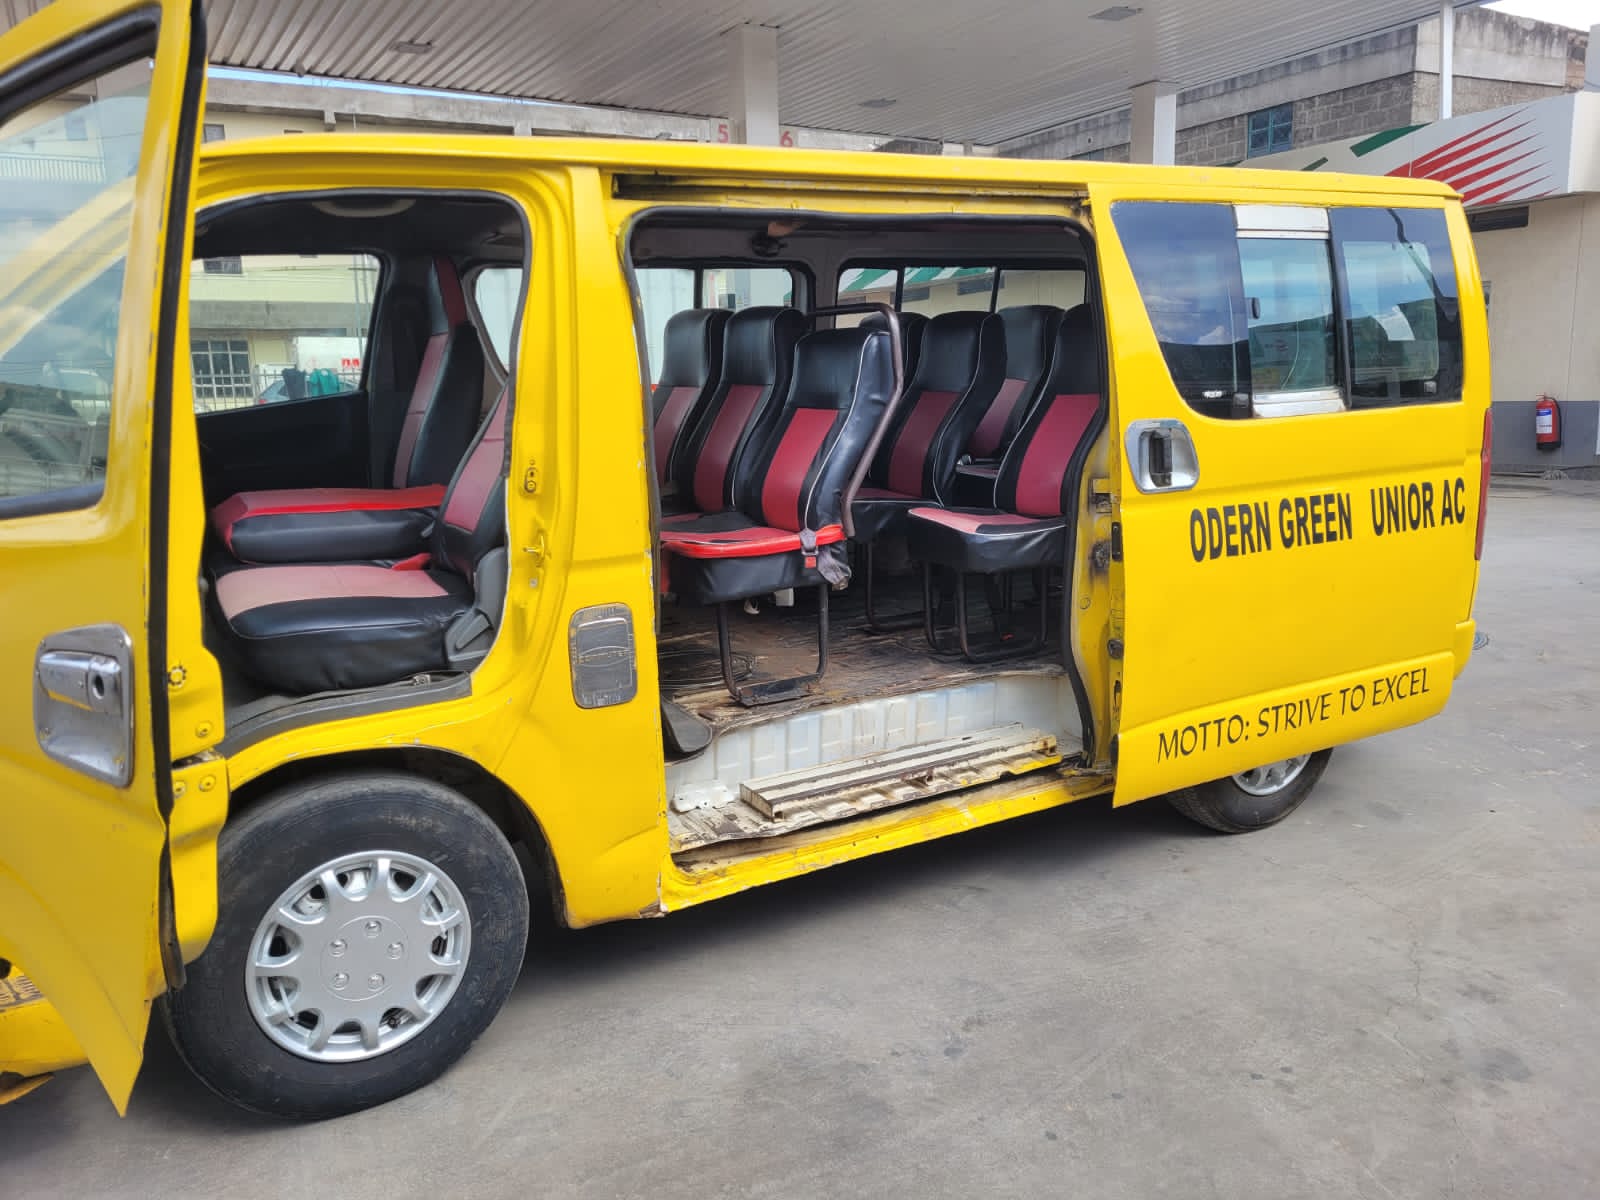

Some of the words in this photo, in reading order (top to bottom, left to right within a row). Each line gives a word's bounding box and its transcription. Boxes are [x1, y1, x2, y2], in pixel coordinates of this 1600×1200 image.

[718, 124, 729, 143] 5
[780, 131, 793, 147] 6
[1189, 501, 1272, 563] ODERN
[1278, 493, 1353, 549] GREEN
[1370, 482, 1435, 537] UNIOR
[1440, 477, 1466, 526] AC
[1157, 714, 1250, 763] MOTTO:
[1257, 692, 1332, 738] STRIVE
[1339, 684, 1365, 716] TO
[1372, 667, 1430, 706] EXCEL
